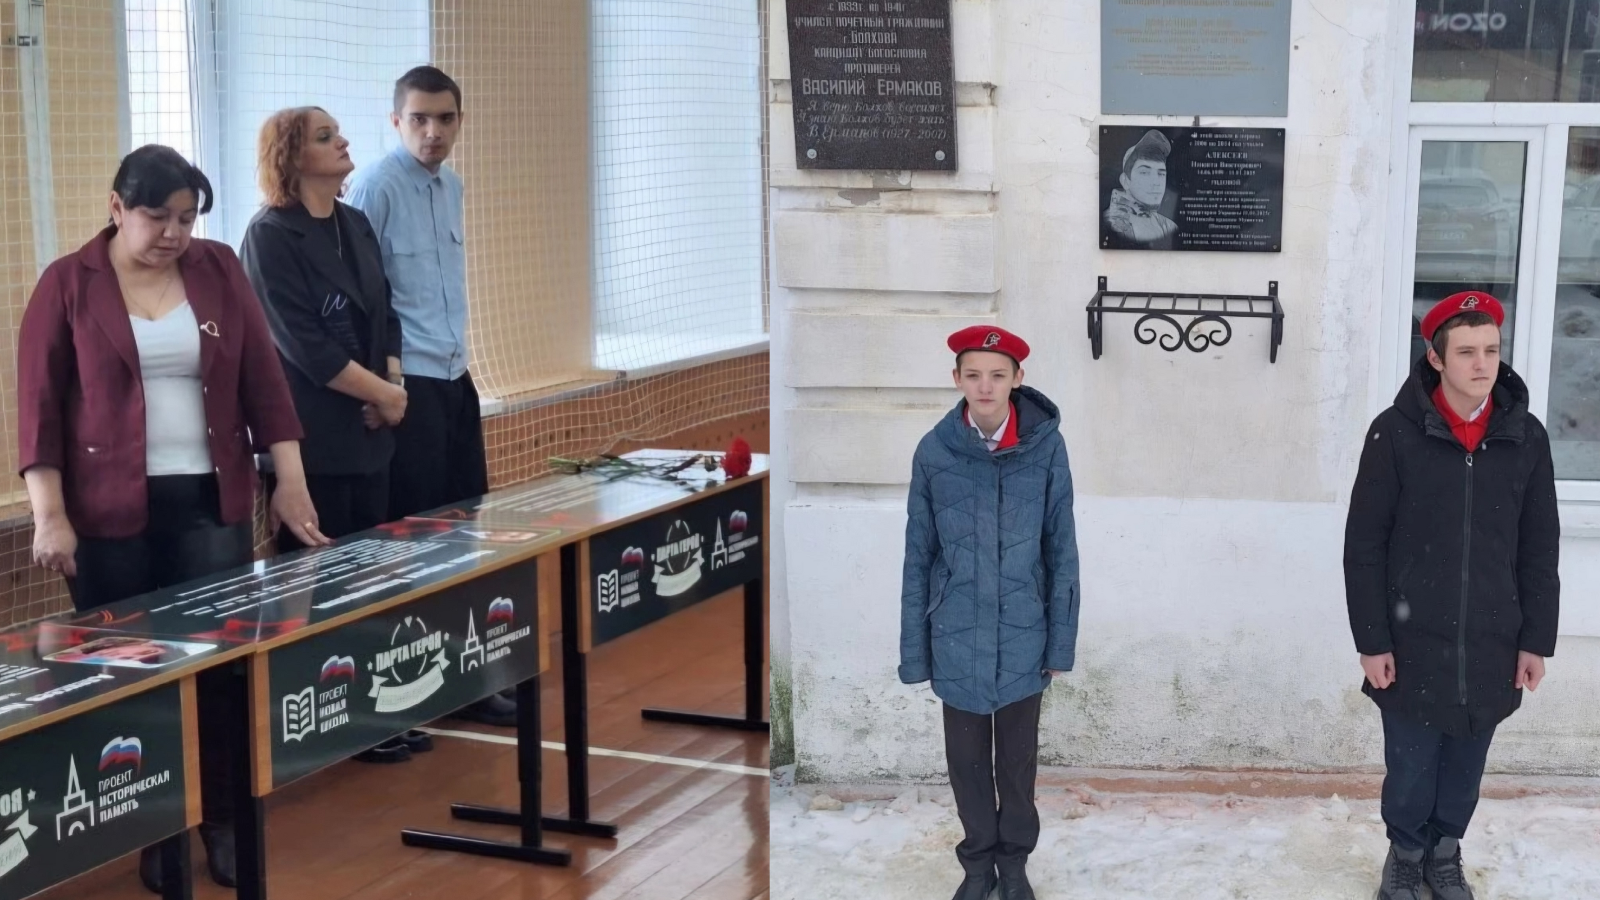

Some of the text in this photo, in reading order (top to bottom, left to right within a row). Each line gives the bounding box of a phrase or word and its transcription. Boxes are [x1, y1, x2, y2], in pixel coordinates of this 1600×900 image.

[795, 17, 832, 28] УЧИЛСЯ
[888, 17, 945, 29] ГРАЖДАНИН
[868, 48, 928, 59] БОГОСЛОВИЯ
[877, 78, 942, 96] ЕРМАКОВ
[375, 630, 442, 673] ПАРТА ГЕРОЯ
[319, 683, 348, 705] ПРОЕКТ
[99, 769, 133, 793] ПРОЕКТ
[99, 770, 169, 808] ИСТОРИЧЕСКАЯ
[99, 798, 139, 823] ПАМЯТЬ
